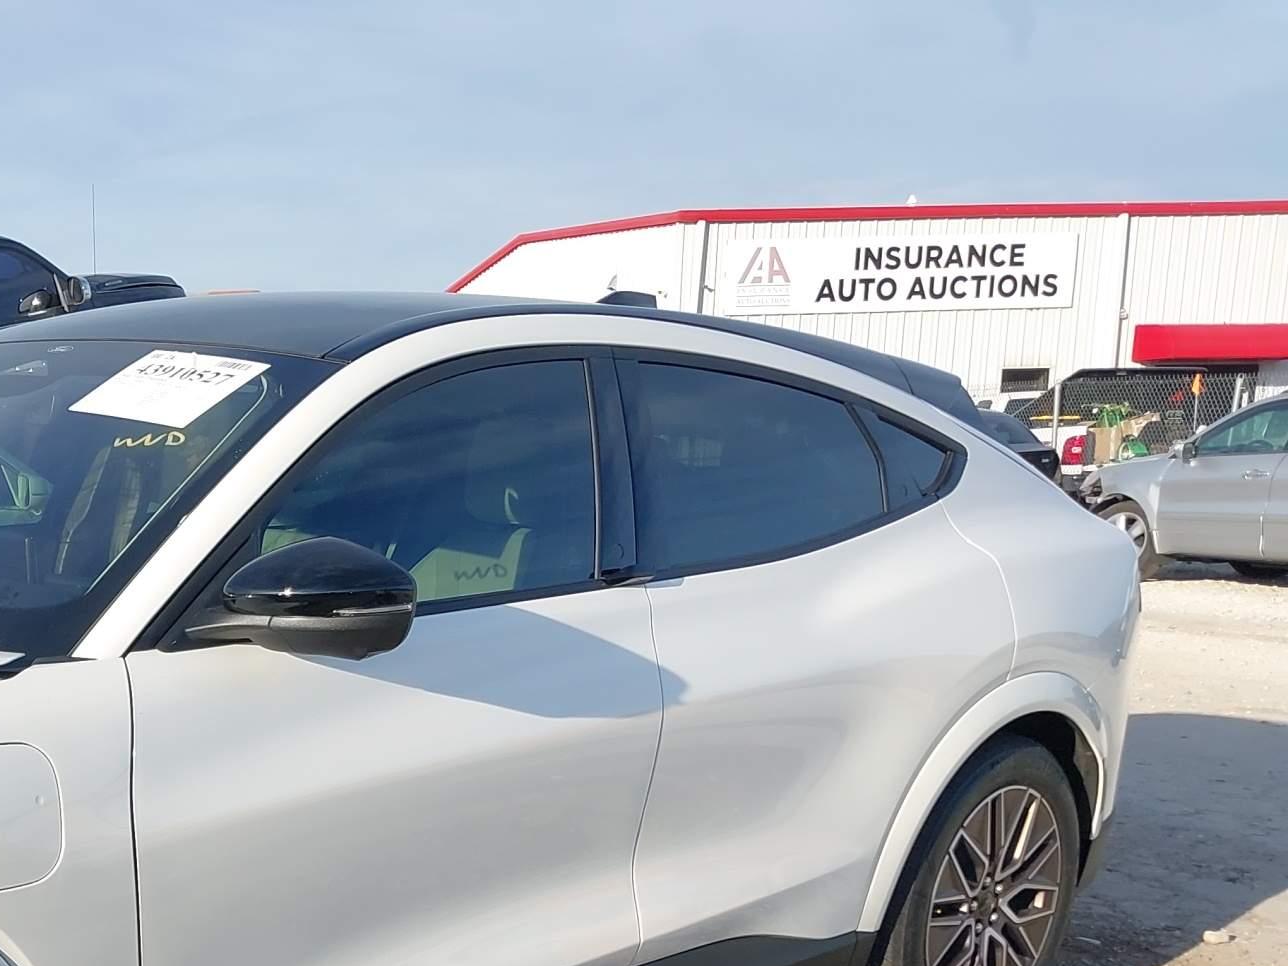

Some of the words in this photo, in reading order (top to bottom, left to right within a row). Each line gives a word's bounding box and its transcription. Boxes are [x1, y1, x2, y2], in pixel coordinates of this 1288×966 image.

[854, 244, 1026, 270] INSURANCE
[815, 277, 897, 302] AUTO
[906, 273, 1058, 300] AUCTIONS
[136, 363, 236, 385] 43910527
